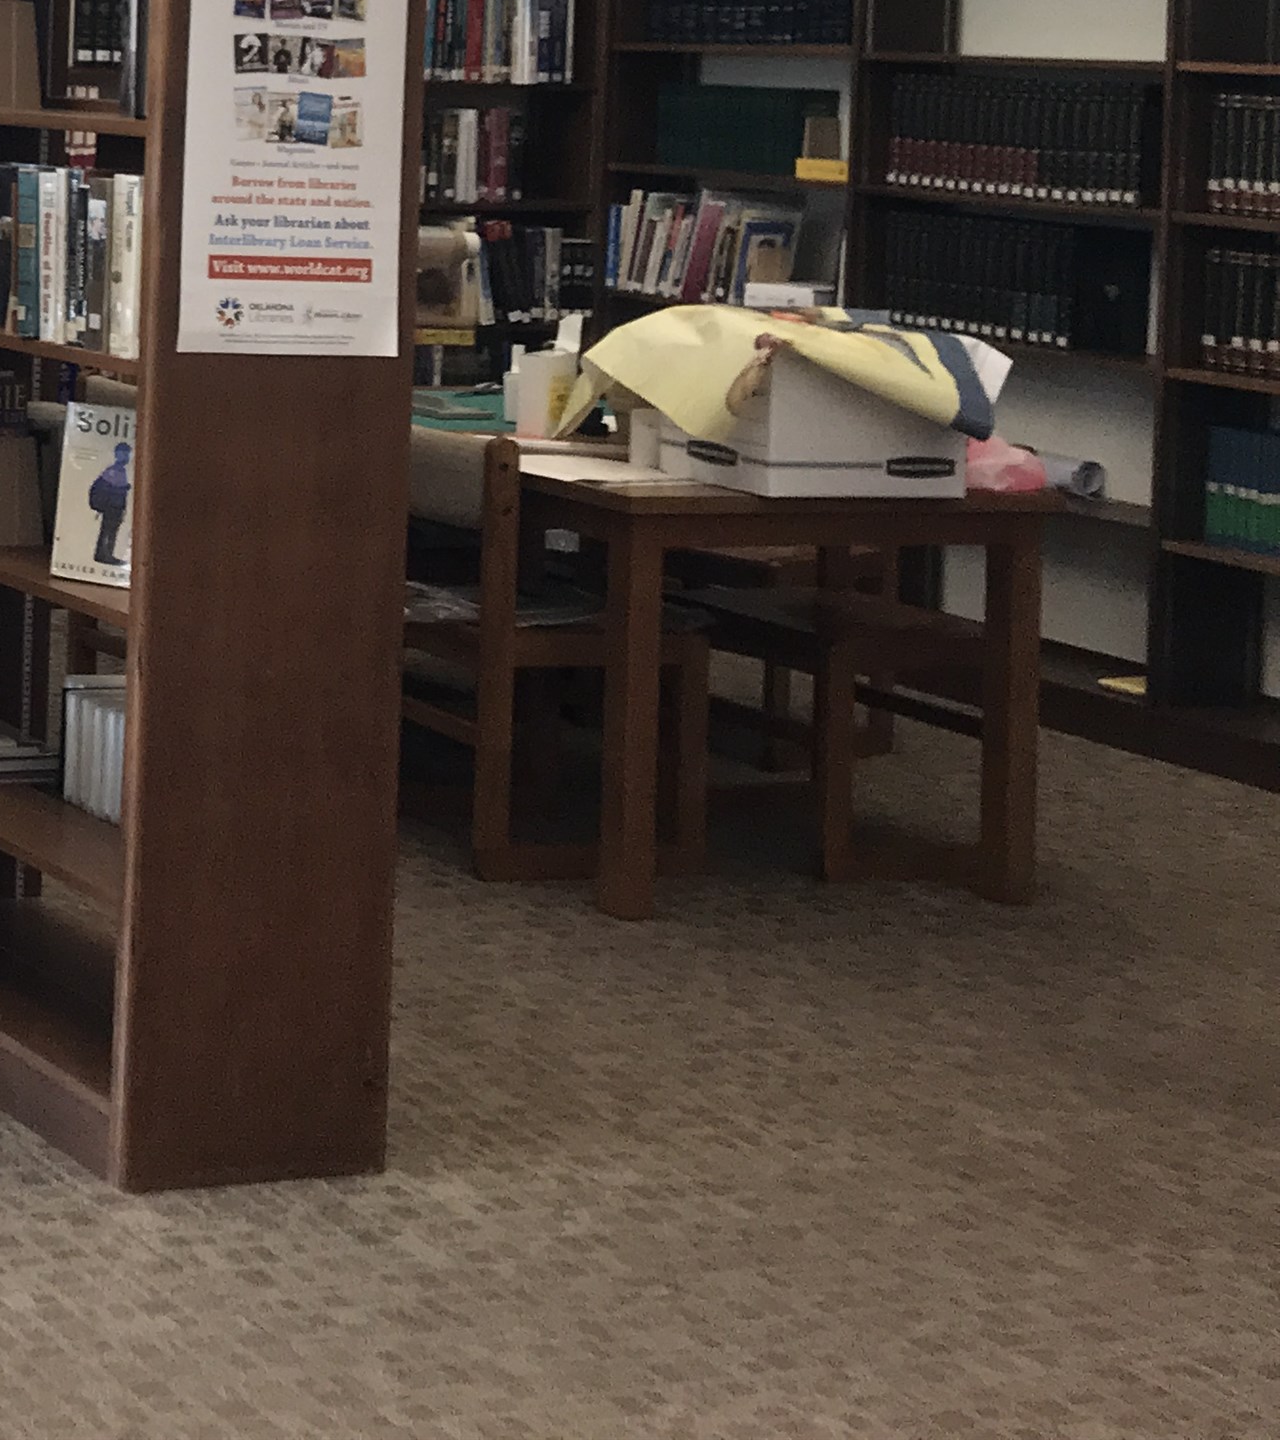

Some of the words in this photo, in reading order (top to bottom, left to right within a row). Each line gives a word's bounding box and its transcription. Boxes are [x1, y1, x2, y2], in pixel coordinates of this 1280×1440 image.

[232, 175, 273, 187] Borrow
[277, 176, 306, 188] from
[308, 178, 356, 190] libraries
[211, 193, 253, 204] around
[256, 193, 274, 205] the
[278, 196, 306, 206] state
[310, 195, 331, 207] and
[215, 213, 238, 227] Ask
[241, 217, 270, 230] your
[274, 216, 331, 229] librarian
[334, 217, 370, 230] about
[208, 233, 286, 250] Interlibrary
[289, 235, 322, 248] Loan
[212, 260, 245, 274] Visit
[247, 262, 369, 281] www.worldcat.org
